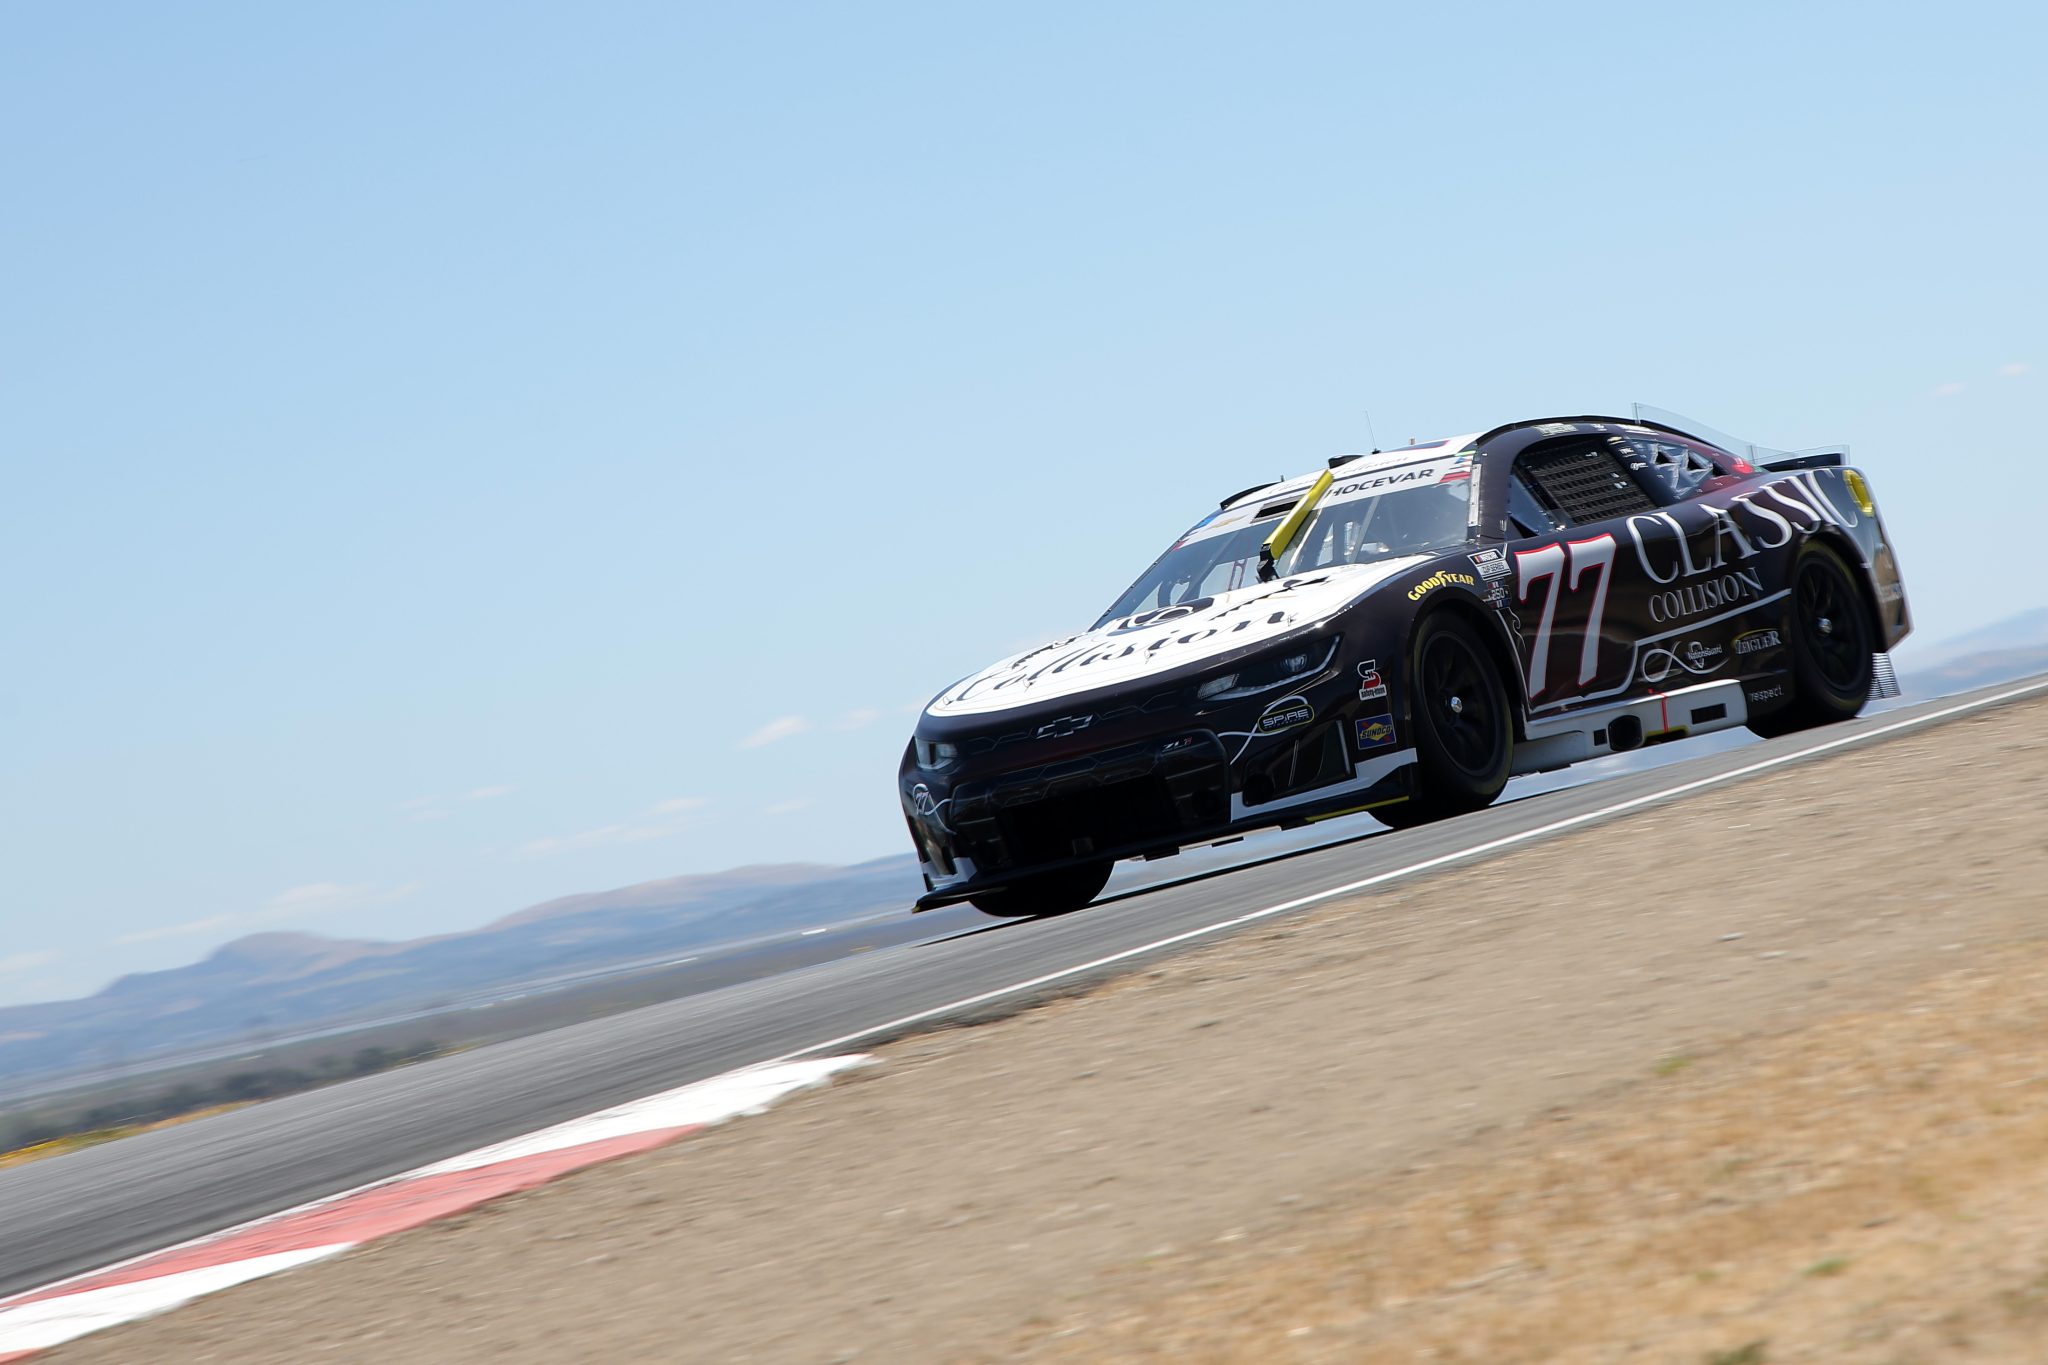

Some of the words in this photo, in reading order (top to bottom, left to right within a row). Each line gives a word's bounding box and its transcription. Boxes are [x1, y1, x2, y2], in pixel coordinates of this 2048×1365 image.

[1325, 469, 1434, 498] HOCEVAR
[1625, 468, 1858, 584] CLASSIC
[1407, 570, 1475, 601] GOODYEAR
[1650, 567, 1763, 623] COLLISION
[1514, 533, 1617, 700] 77
[1735, 630, 1782, 654] ZEIGLER
[1263, 708, 1309, 727] SPIRE
[1361, 725, 1393, 739] SUNOCO
